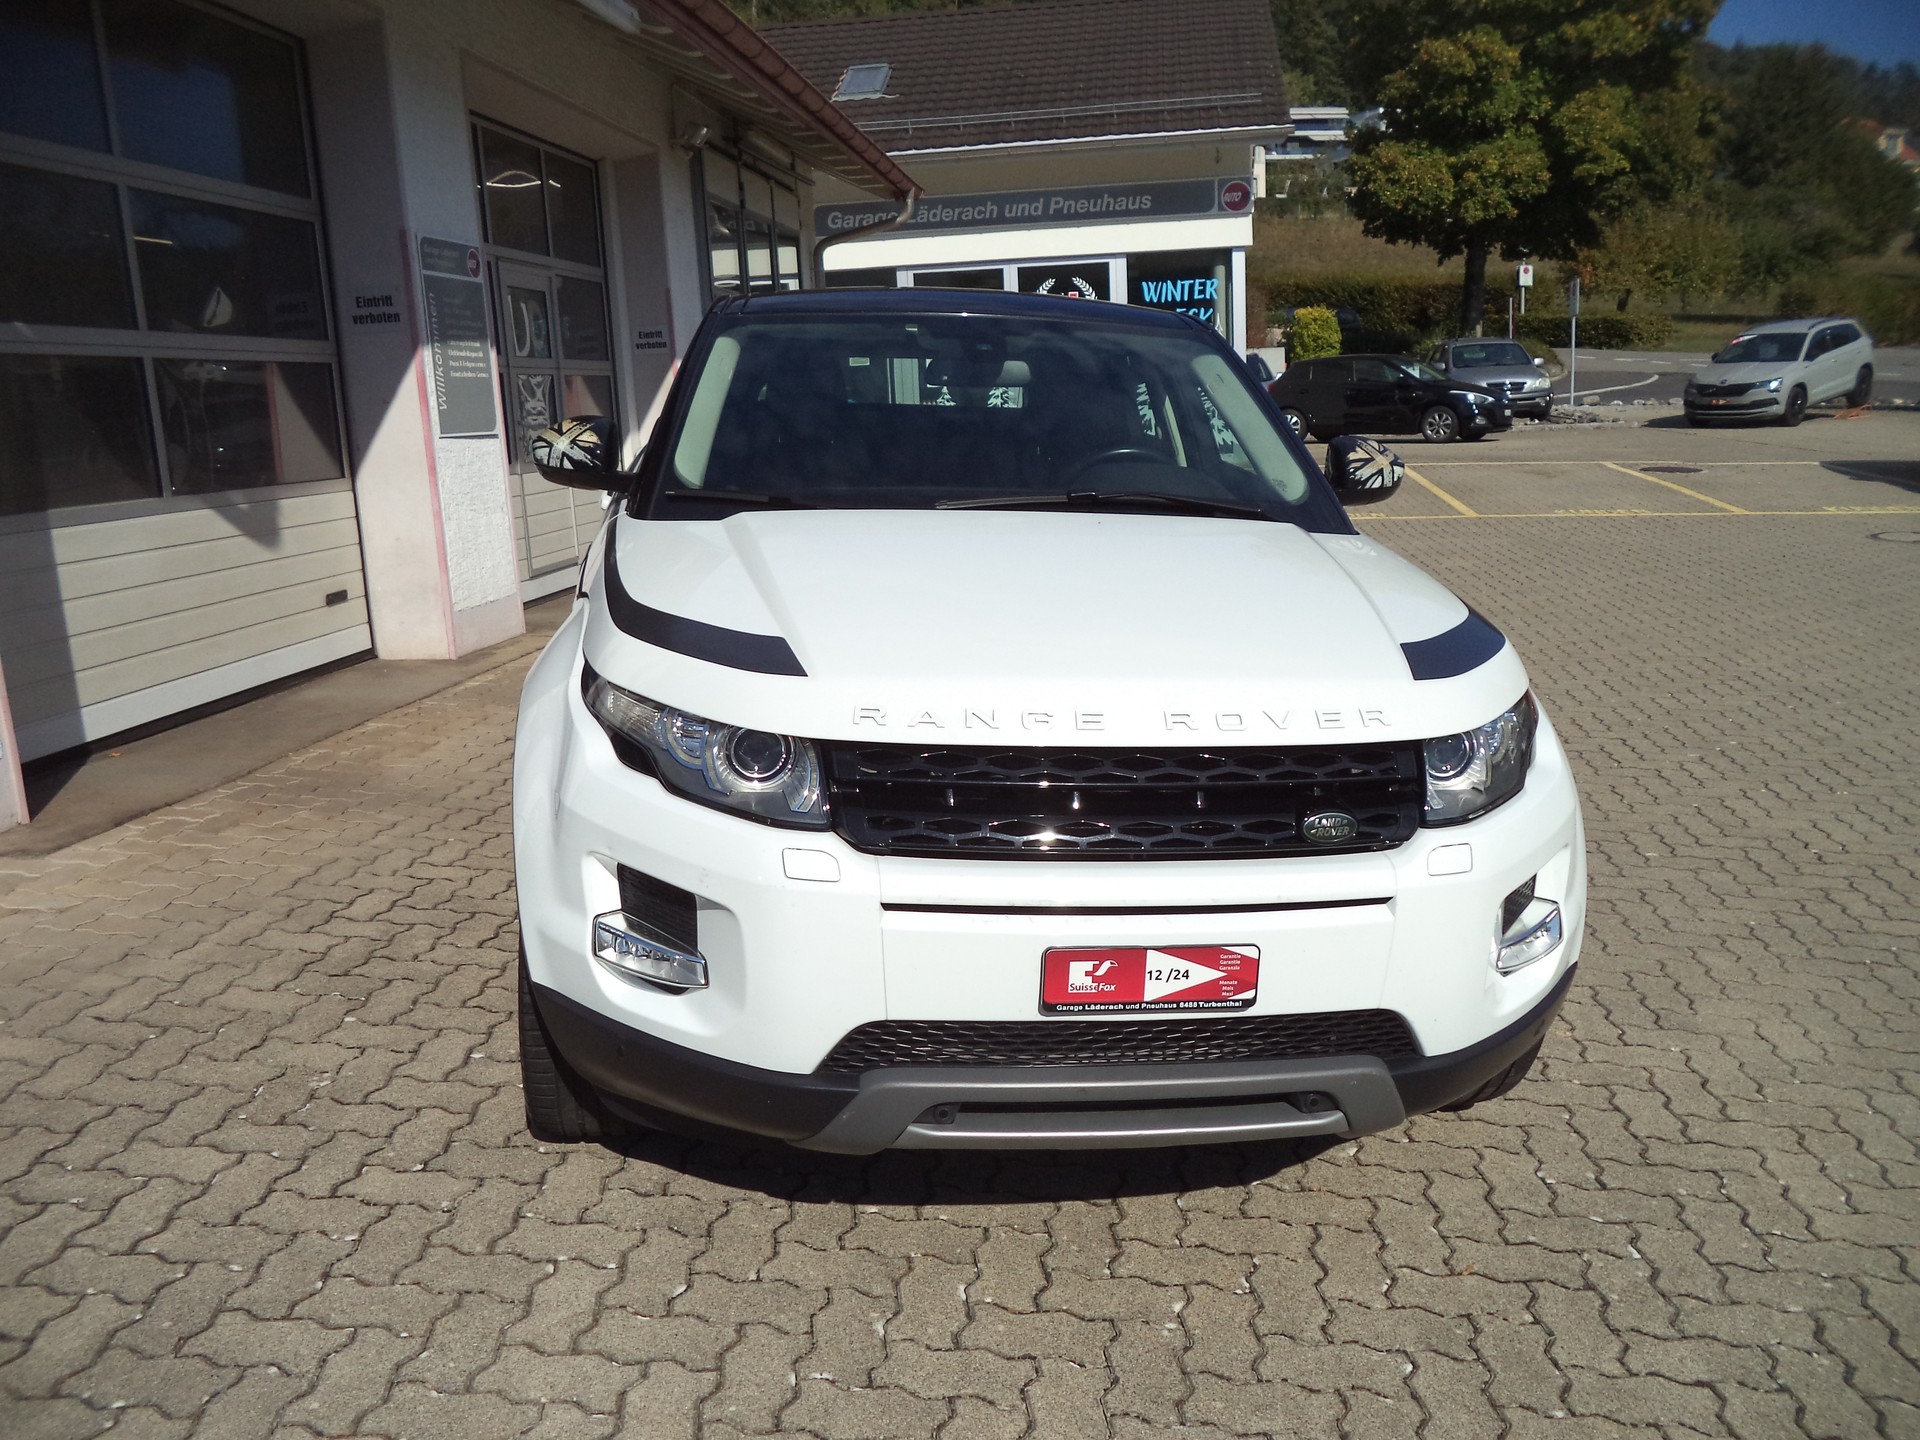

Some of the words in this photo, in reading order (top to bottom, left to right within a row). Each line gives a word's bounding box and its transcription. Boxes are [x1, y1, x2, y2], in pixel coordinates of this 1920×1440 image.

[1004, 198, 1044, 217] und
[1049, 194, 1152, 215] Pneuhaus
[1141, 278, 1219, 303] WINTER
[355, 295, 393, 308] Eintritt
[352, 311, 401, 325] verboten
[638, 330, 663, 339] Eintritt
[635, 341, 668, 350] verboten
[852, 704, 1106, 731] RANGE
[1163, 707, 1392, 732] ROVER
[1314, 817, 1342, 828] LAND
[1316, 826, 1350, 837] ROVER
[1147, 969, 1163, 981] 12
[1165, 968, 1190, 983] /24
[1056, 1004, 1083, 1012] Garage
[1085, 1002, 1124, 1010] Läderach
[1125, 1002, 1140, 1010] und
[1141, 1001, 1177, 1009] Pneuhaus
[1198, 1000, 1242, 1008] Turbenthal
